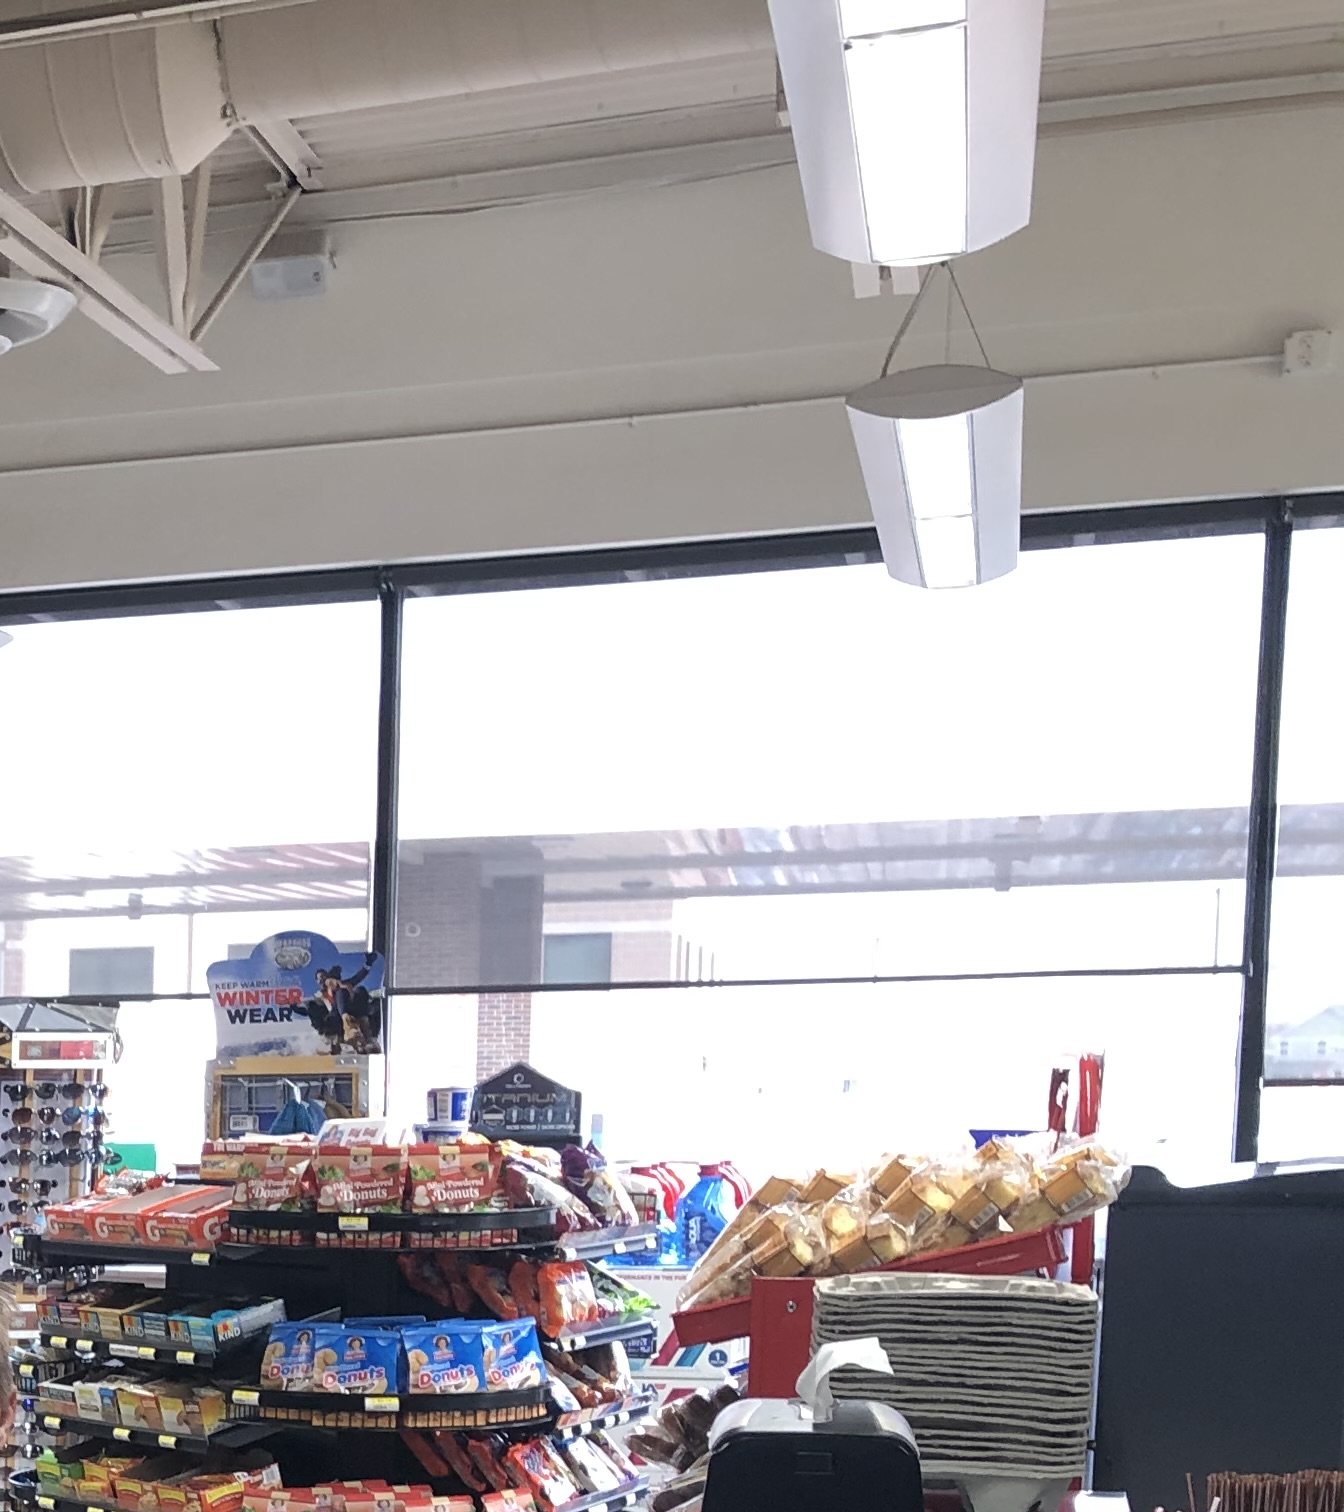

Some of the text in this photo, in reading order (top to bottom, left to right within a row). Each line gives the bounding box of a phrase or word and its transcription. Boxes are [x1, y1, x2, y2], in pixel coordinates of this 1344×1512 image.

[215, 982, 238, 990] KEEP
[216, 988, 302, 1007] WINTER
[227, 1007, 293, 1024] WEAR
[252, 1186, 290, 1198] Donuts
[343, 1187, 387, 1201] Donuts
[434, 1186, 480, 1201] Donuts
[46, 1214, 59, 1235] G
[95, 1217, 109, 1238] G
[146, 1220, 160, 1241] G
[203, 1216, 221, 1241] G
[124, 1327, 145, 1337] KIND
[218, 1328, 241, 1342] KIND
[268, 1364, 312, 1379] Donu
[322, 1367, 385, 1388] Donuts
[419, 1365, 475, 1386] Donuts
